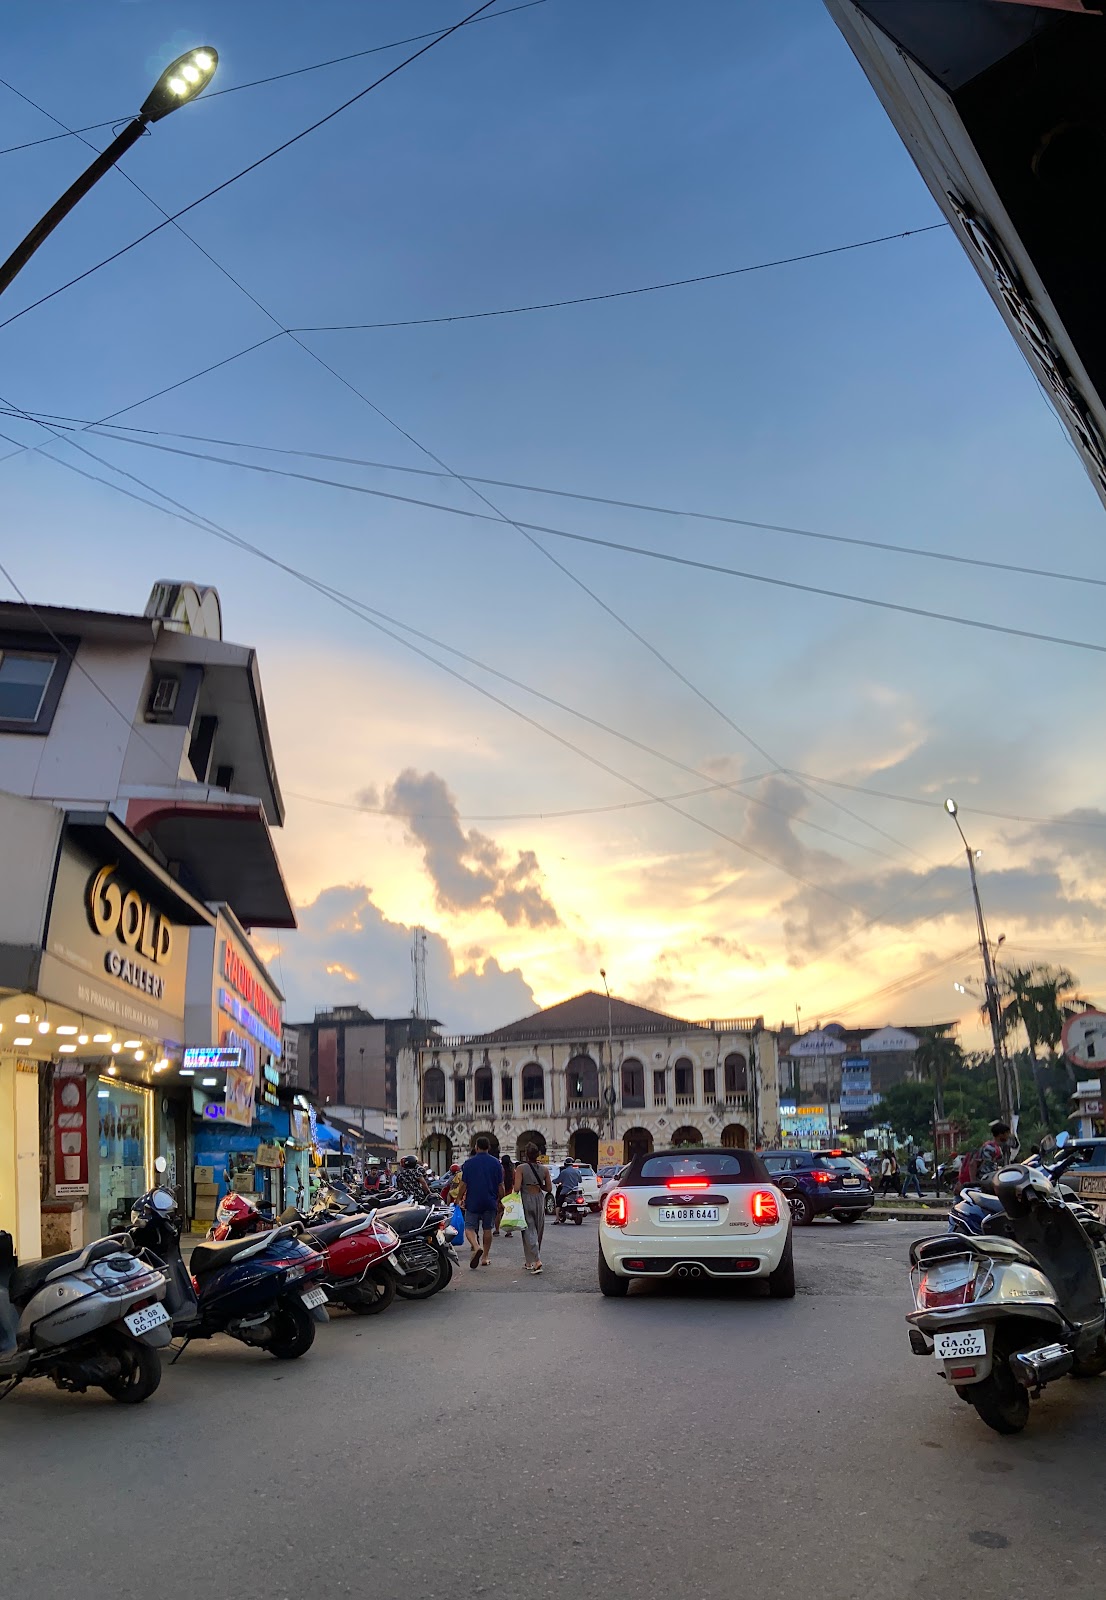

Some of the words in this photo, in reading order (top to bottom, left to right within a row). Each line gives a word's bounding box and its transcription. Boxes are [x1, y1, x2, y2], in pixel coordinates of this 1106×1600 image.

[88, 864, 172, 966] GOLD
[107, 949, 166, 999] GALLERY
[224, 939, 252, 1003] RADIO
[665, 1210, 676, 1219] GA
[677, 1209, 688, 1219] 08
[689, 1209, 695, 1219] R
[696, 1209, 717, 1219] 6441
[135, 1313, 167, 1334] AG.7774
[938, 1346, 982, 1357] V.7097
[941, 1337, 977, 1348] GA.07
